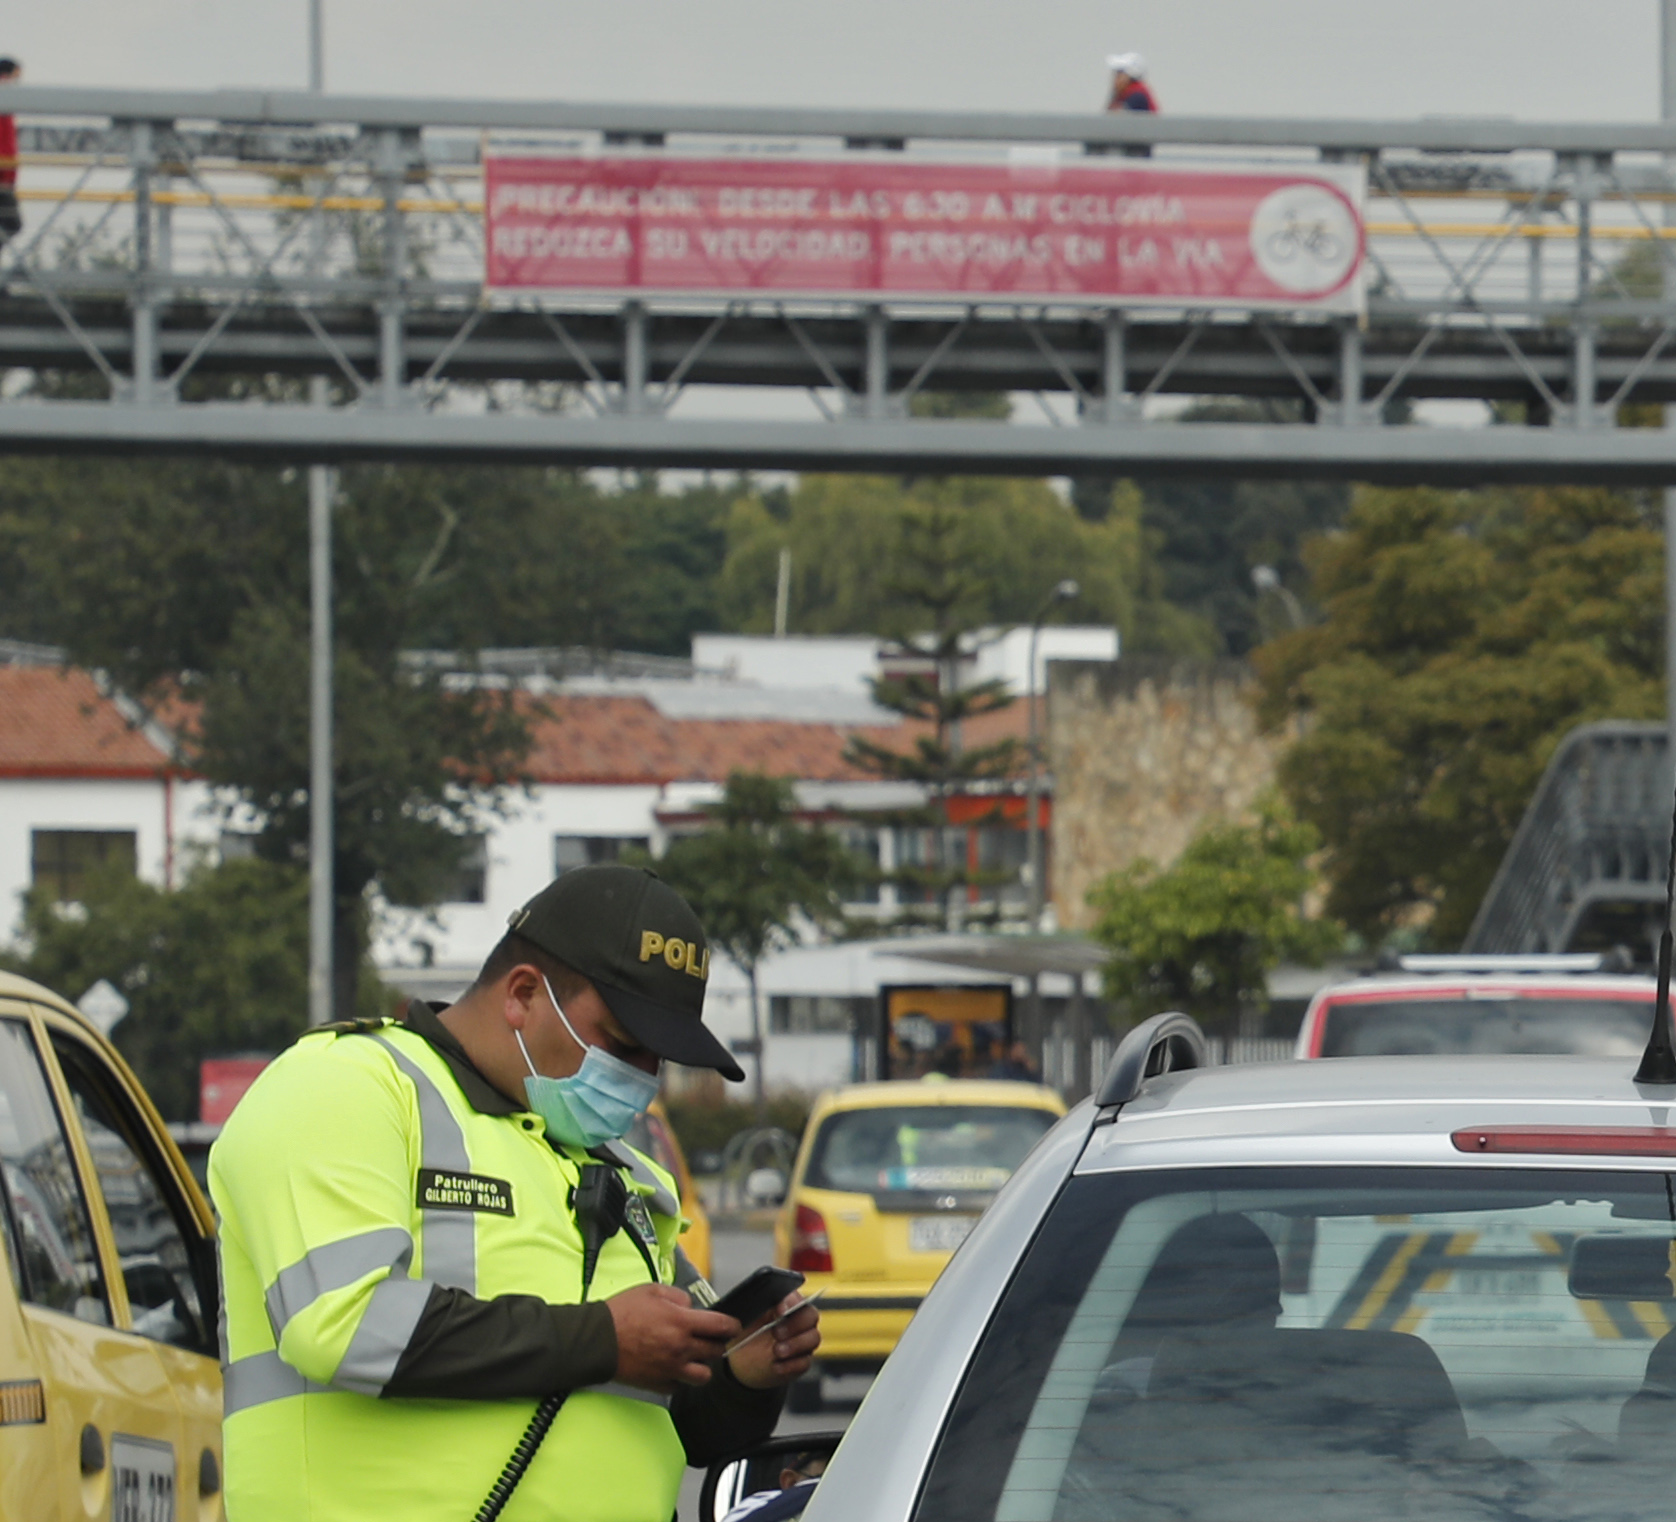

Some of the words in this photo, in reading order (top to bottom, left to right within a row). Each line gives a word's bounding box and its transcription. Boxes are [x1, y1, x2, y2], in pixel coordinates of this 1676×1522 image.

[716, 187, 817, 219] DESDE
[828, 190, 892, 219] LAS
[495, 226, 634, 259] REDUZCA
[645, 227, 690, 260] SU
[889, 231, 1054, 263] PERSONAS
[1063, 235, 1106, 267] EN
[1117, 237, 1158, 268] LA
[639, 929, 710, 981] POLI
[425, 1187, 473, 1206] GILBERTO
[476, 1192, 507, 1210] ROJAS
[434, 1174, 498, 1195] Patrullero
